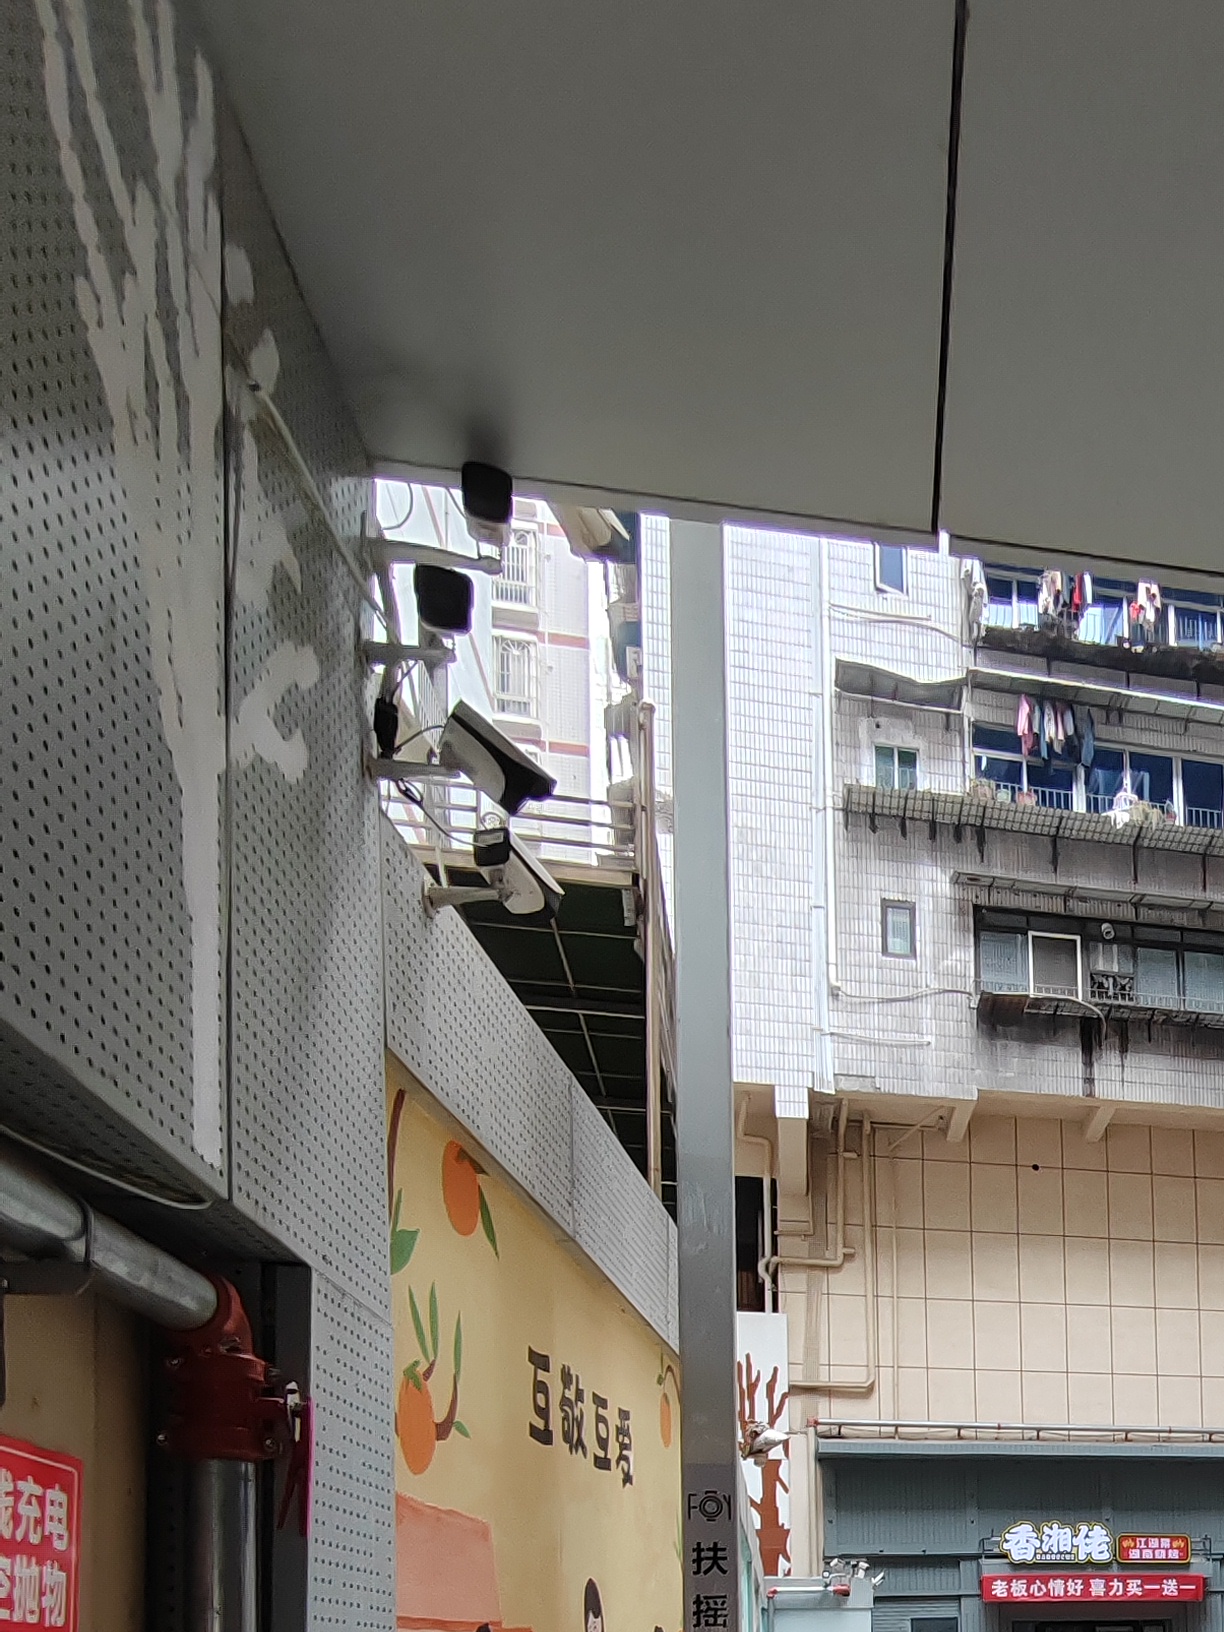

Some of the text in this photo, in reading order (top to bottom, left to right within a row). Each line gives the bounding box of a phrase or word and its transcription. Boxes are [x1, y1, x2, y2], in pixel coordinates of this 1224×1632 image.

[528, 1345, 633, 1489] 互敬互爱
[1003, 1522, 1112, 1562] 香湘佬
[991, 1578, 1196, 1598] 老板心情好 喜力买一送一
